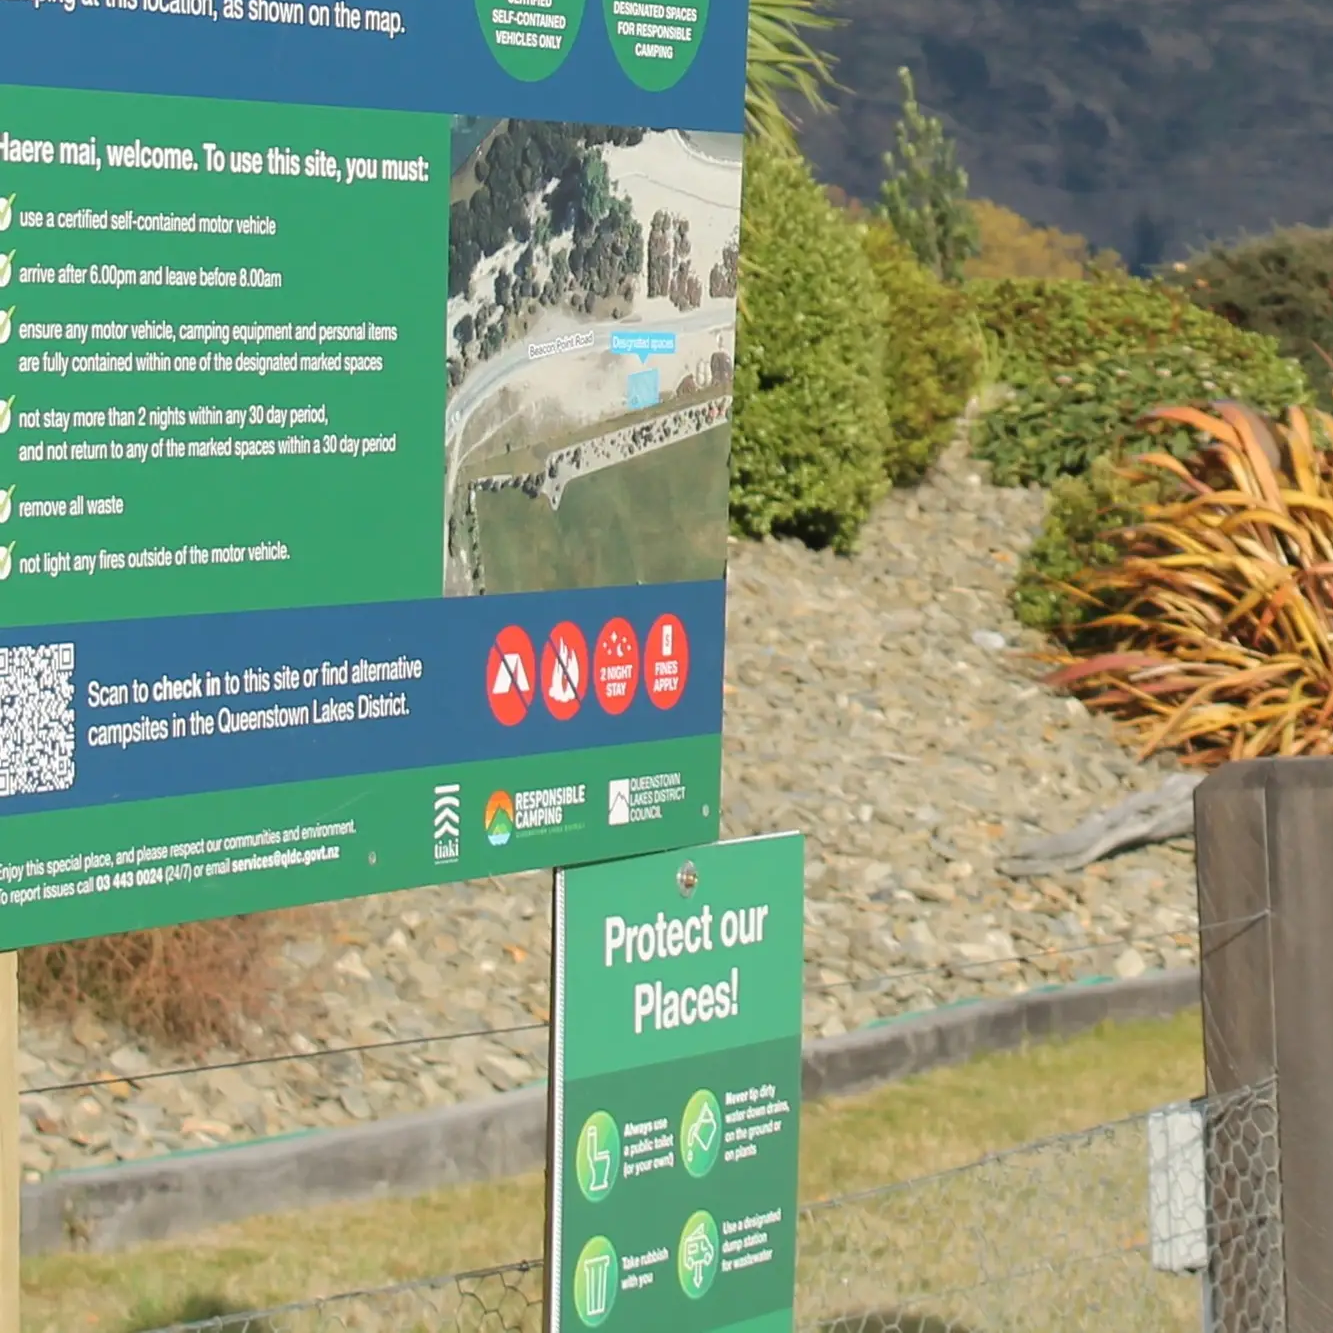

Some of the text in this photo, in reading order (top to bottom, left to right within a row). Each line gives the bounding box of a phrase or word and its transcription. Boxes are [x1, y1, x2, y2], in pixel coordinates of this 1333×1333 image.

[308, 4, 330, 26] on
[333, 0, 361, 29] the
[364, 9, 405, 39] map.
[491, 8, 566, 29] SELF-CONTAINED
[613, 0, 697, 22] DESIGNATED SPACES
[495, 29, 562, 49] VEHICLES ONLY
[617, 20, 692, 41] FOR RESPONSIBLE
[634, 42, 673, 59] CAMPING
[59, 136, 101, 171] mai,
[106, 138, 198, 171] welcome.
[202, 142, 225, 172] To
[229, 151, 263, 174] use
[266, 146, 300, 176] this
[304, 148, 341, 182] site,
[345, 157, 378, 184] you
[381, 155, 429, 182] must:
[19, 209, 276, 235] use a certified self-contained motor vehicle
[18, 263, 282, 289] arrive after 6.00pm and leave before 8.00am
[18, 319, 397, 345] ensure any motor vehicle, camping equipment and personal items
[529, 333, 593, 357] Beacon Point Road
[18, 351, 383, 377] are fully contained within one of the designated marked spaces
[18, 404, 328, 432] not stay more than 2 nights within any 30 day period,
[18, 433, 396, 463] and not return to any of the marked spaces within a 30 day period
[18, 495, 124, 517] remove all waste
[19, 540, 290, 577] not light any fires outside of the motor vehicle.
[600, 664, 633, 681] 2 NIGHT
[654, 660, 678, 675] FINES
[87, 655, 422, 707] Scan to check in to this site or find alternative
[606, 682, 626, 697] STAY
[653, 676, 679, 692] APPLY
[87, 691, 409, 749] campsites in the Queenstown Lakes District.
[630, 773, 681, 791] QUEENSTOWN
[514, 784, 585, 811] RESPONSIBLE
[630, 786, 685, 806] LAKES DISTRICT
[514, 805, 562, 829] CAMPING
[630, 805, 662, 822] COUNCIL
[434, 837, 459, 859] tiaki
[8, 879, 41, 906] report
[42, 875, 75, 899] issues
[76, 876, 94, 894] call
[95, 874, 111, 892] 03
[111, 870, 134, 889] 443
[135, 867, 164, 886] 0024
[164, 862, 192, 885] (24/7)
[192, 864, 204, 878] or
[205, 857, 231, 876] email
[230, 845, 340, 872] services@qldc.govt.nz
[605, 905, 768, 967] Protect our
[634, 967, 738, 1034] Places!
